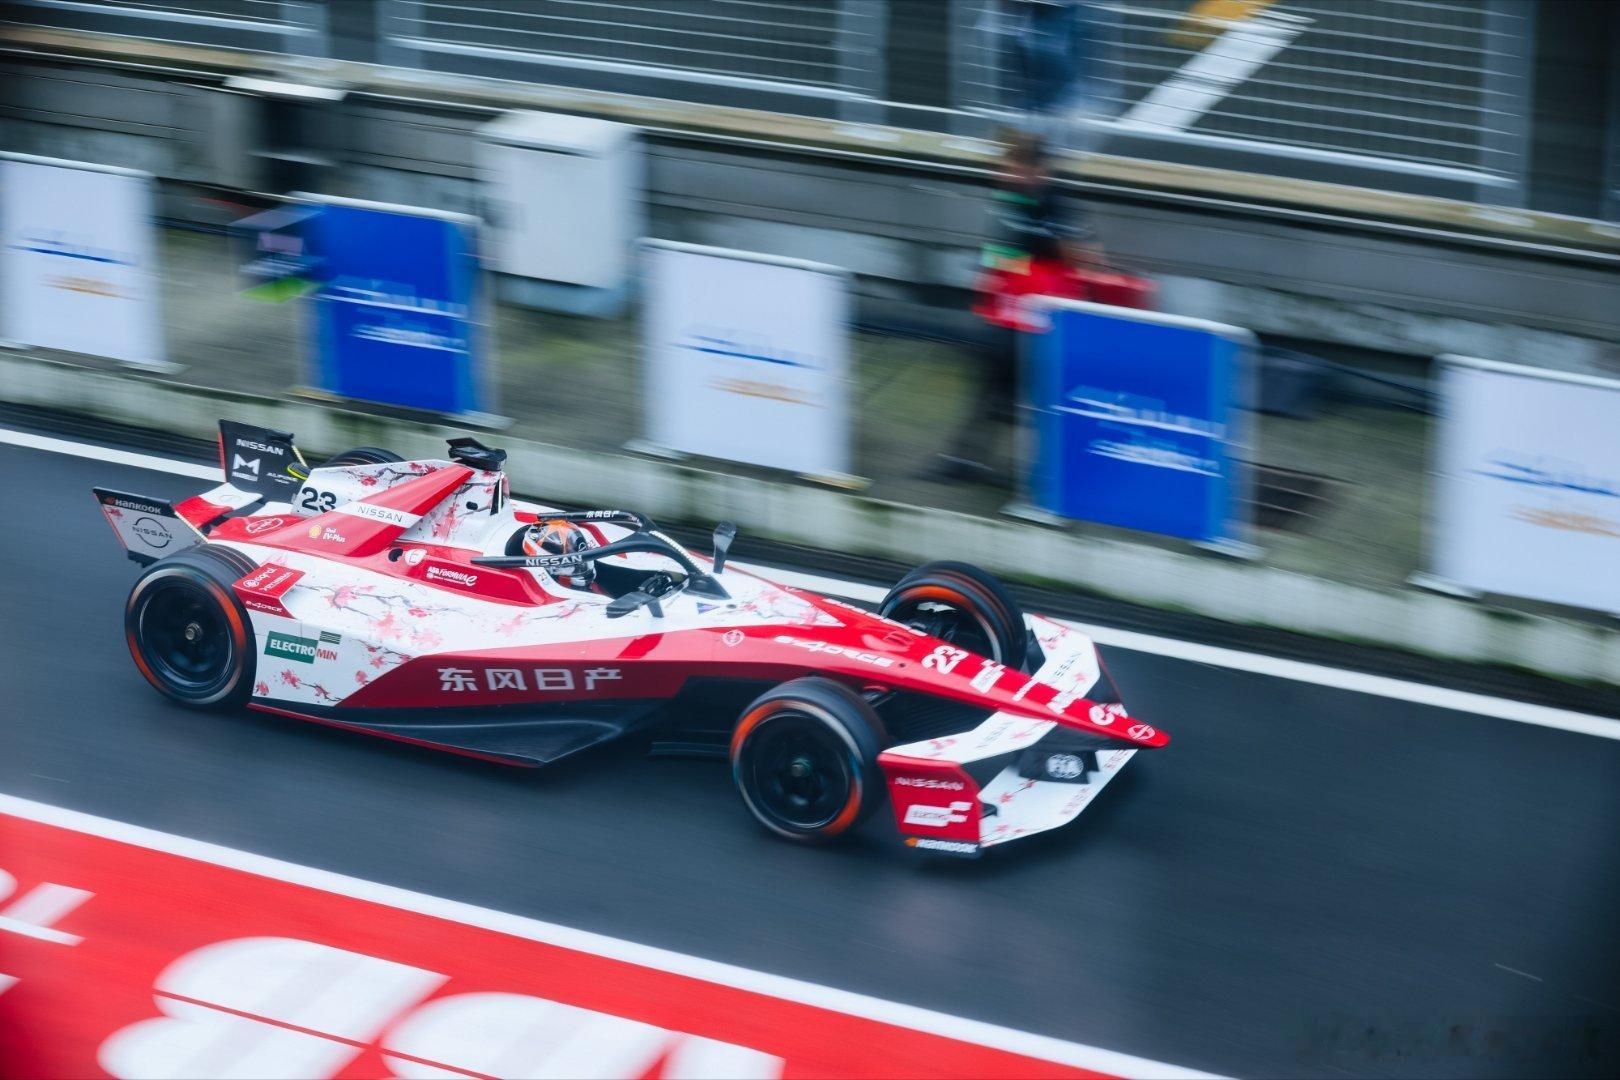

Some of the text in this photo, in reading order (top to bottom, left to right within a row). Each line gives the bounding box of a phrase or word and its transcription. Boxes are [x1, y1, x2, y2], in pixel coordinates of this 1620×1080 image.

[235, 438, 285, 456] NISSAN
[301, 486, 337, 513] 23
[357, 505, 403, 522] NISSAN
[132, 526, 173, 539] NISSAN
[525, 555, 582, 566] NISSAN
[270, 638, 338, 661] ELECTROMIN
[921, 645, 969, 674] 23
[437, 668, 623, 692] 东风日产
[895, 777, 964, 791] NISSAN
